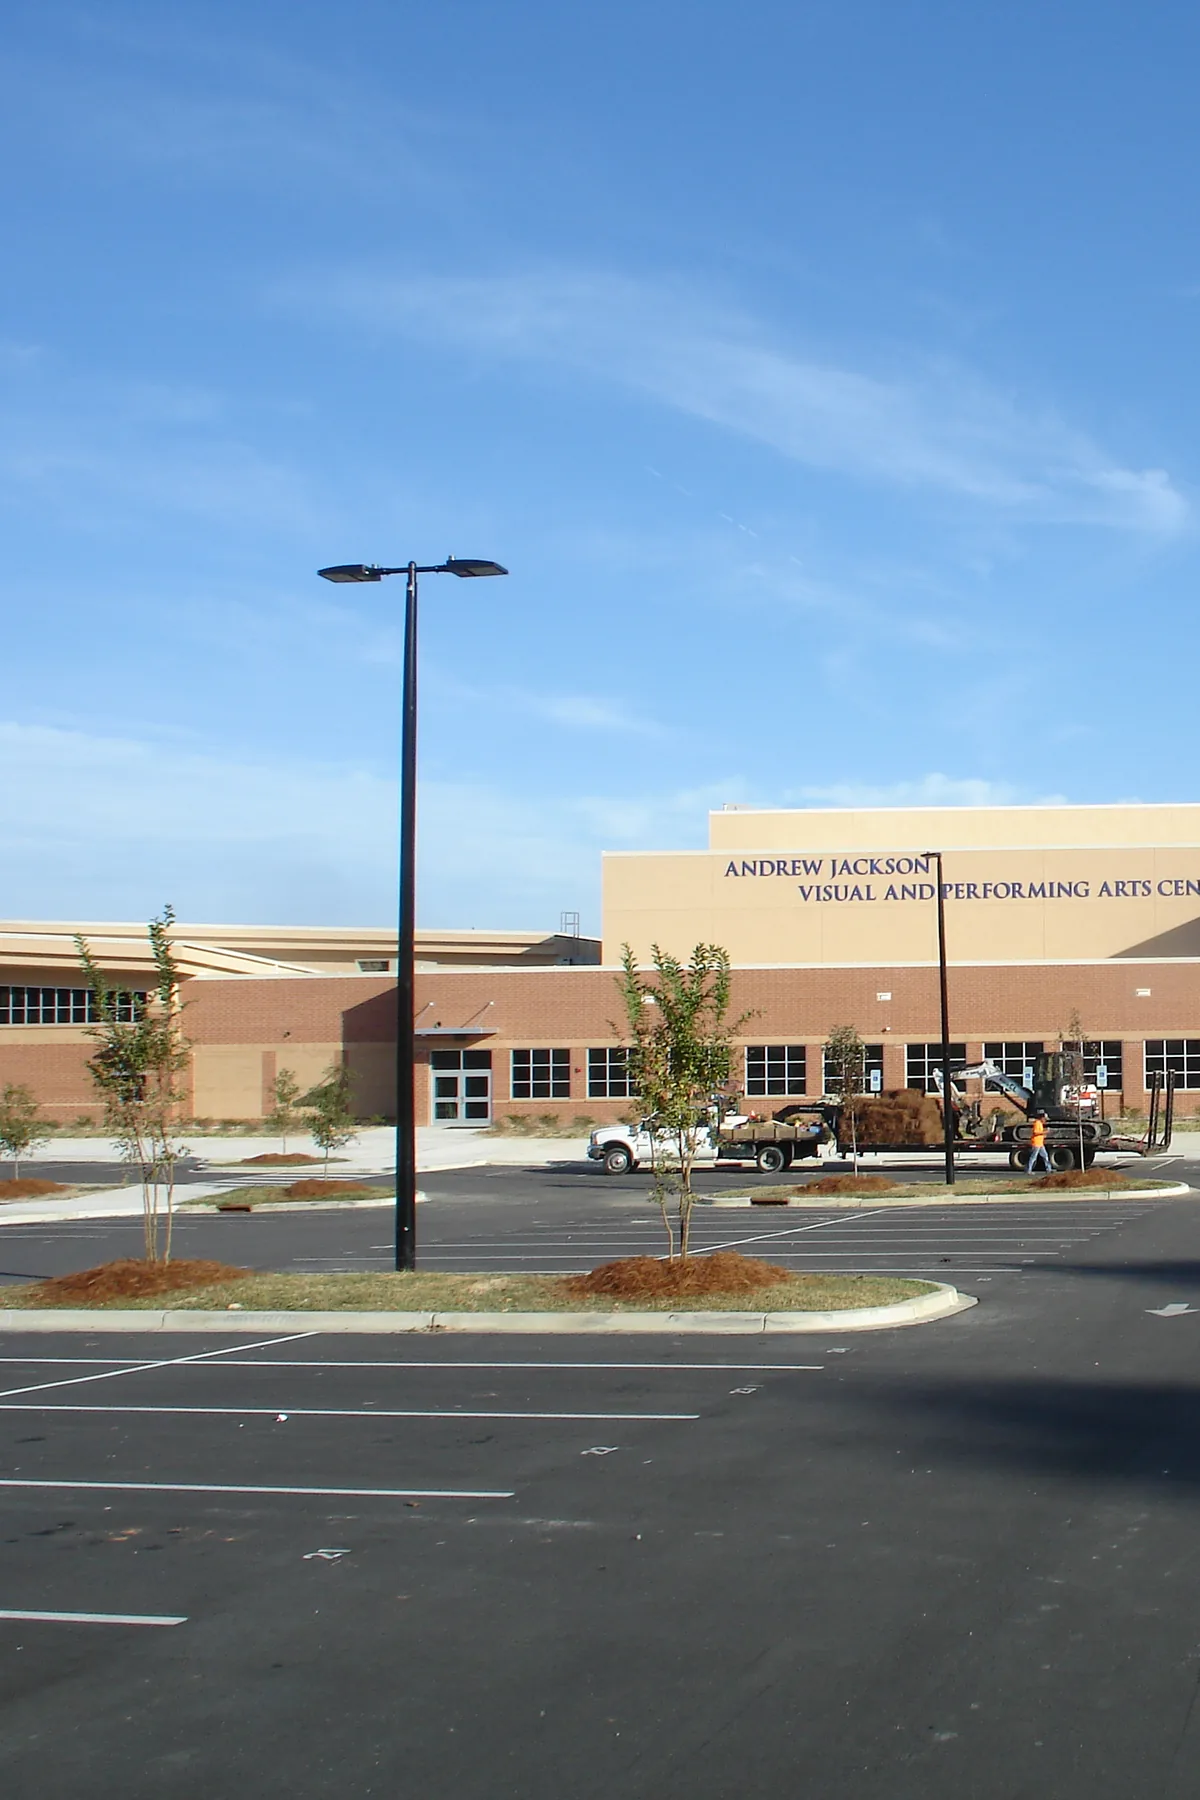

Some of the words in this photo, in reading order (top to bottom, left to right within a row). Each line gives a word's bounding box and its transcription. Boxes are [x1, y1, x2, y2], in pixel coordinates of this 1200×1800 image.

[723, 859, 823, 877] ANDREW
[830, 857, 930, 879] JACKSON
[798, 884, 877, 903] VISUAL
[883, 883, 936, 901] AND
[941, 881, 1091, 900] PERFORMING
[1097, 880, 1152, 899] ARTS
